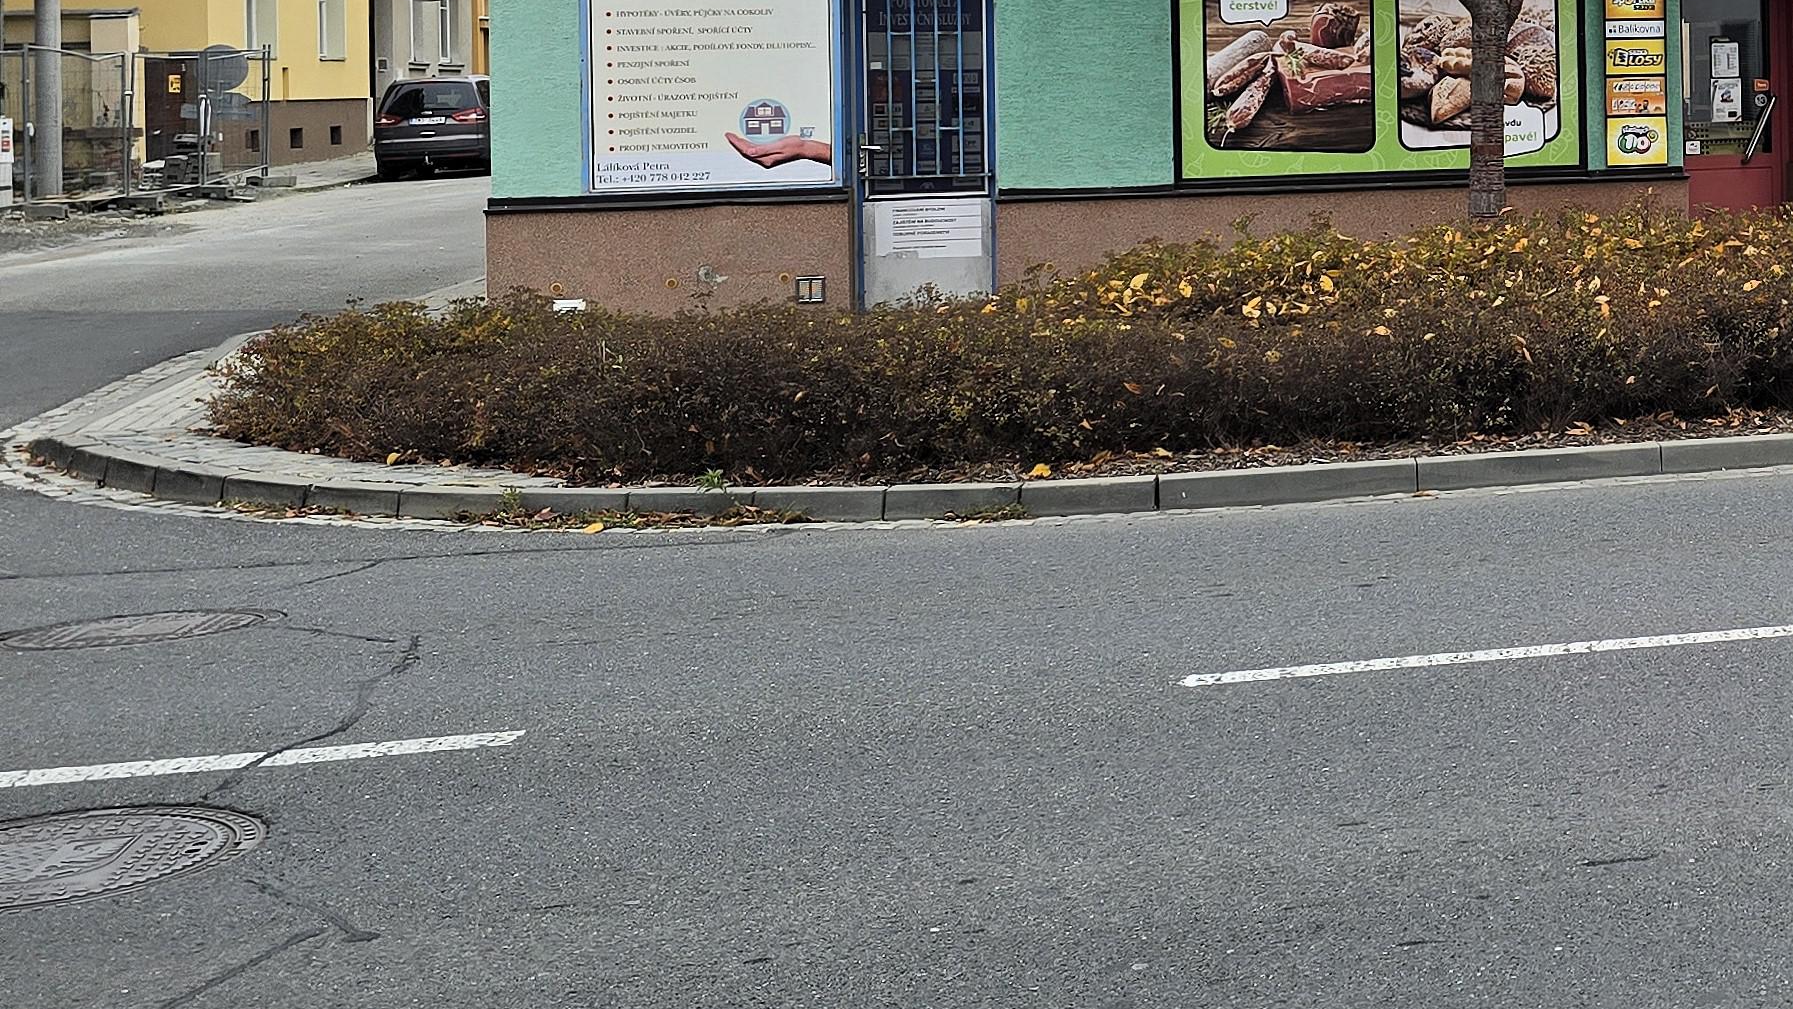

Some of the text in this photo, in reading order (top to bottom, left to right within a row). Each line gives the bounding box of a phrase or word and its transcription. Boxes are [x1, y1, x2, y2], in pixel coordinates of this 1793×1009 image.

[661, 110, 698, 119] MAJETKU
[661, 127, 697, 135] VOZIDEL
[1505, 132, 1537, 143] pavé!
[619, 143, 708, 153] PRODEJ NEMOVITOSTI
[643, 162, 670, 171] Petra
[650, 173, 668, 182] 778
[671, 173, 690, 181] 042
[692, 172, 711, 181] 227
